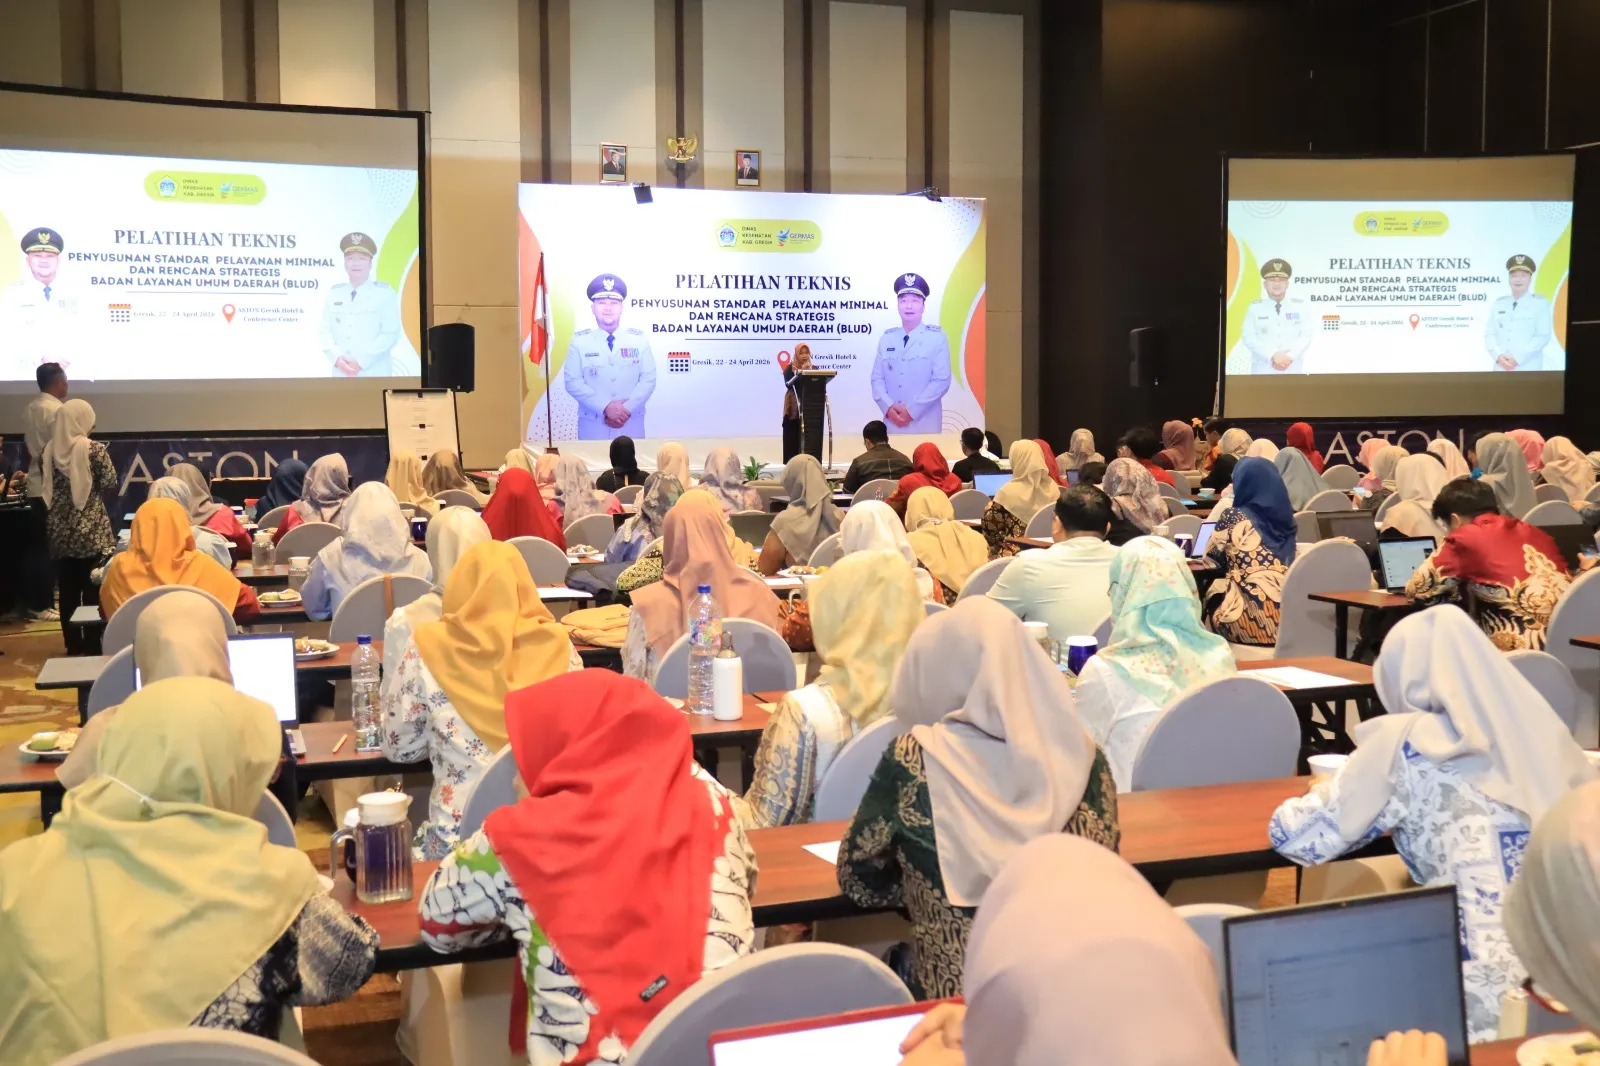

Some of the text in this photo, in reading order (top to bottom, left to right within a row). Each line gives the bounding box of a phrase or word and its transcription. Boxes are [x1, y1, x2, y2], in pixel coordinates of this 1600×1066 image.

[114, 230, 296, 248] PELATIHAN TEKNIS
[68, 252, 335, 267] PENYUSUNAN STANDAR PELAYANAN MINIMAL
[1329, 258, 1471, 270] PELATIHAN TEKNIS
[129, 266, 280, 277] DAN RENCANA STRATEGIS
[91, 277, 319, 290] BADAN LAYANAN UMUM DAERAH (BLUD)
[676, 274, 851, 290] PELATIHAN TEKNIS
[1458, 293, 1487, 302] (BLUD)
[631, 299, 888, 309] PENYUSUNAN STANDAR PELAYANAN MINIMAL
[689, 312, 835, 321] DAN RENCANA STRATEGIS
[652, 323, 872, 335] BADAN LAYANAN UMUM DAERAH (BLUD)
